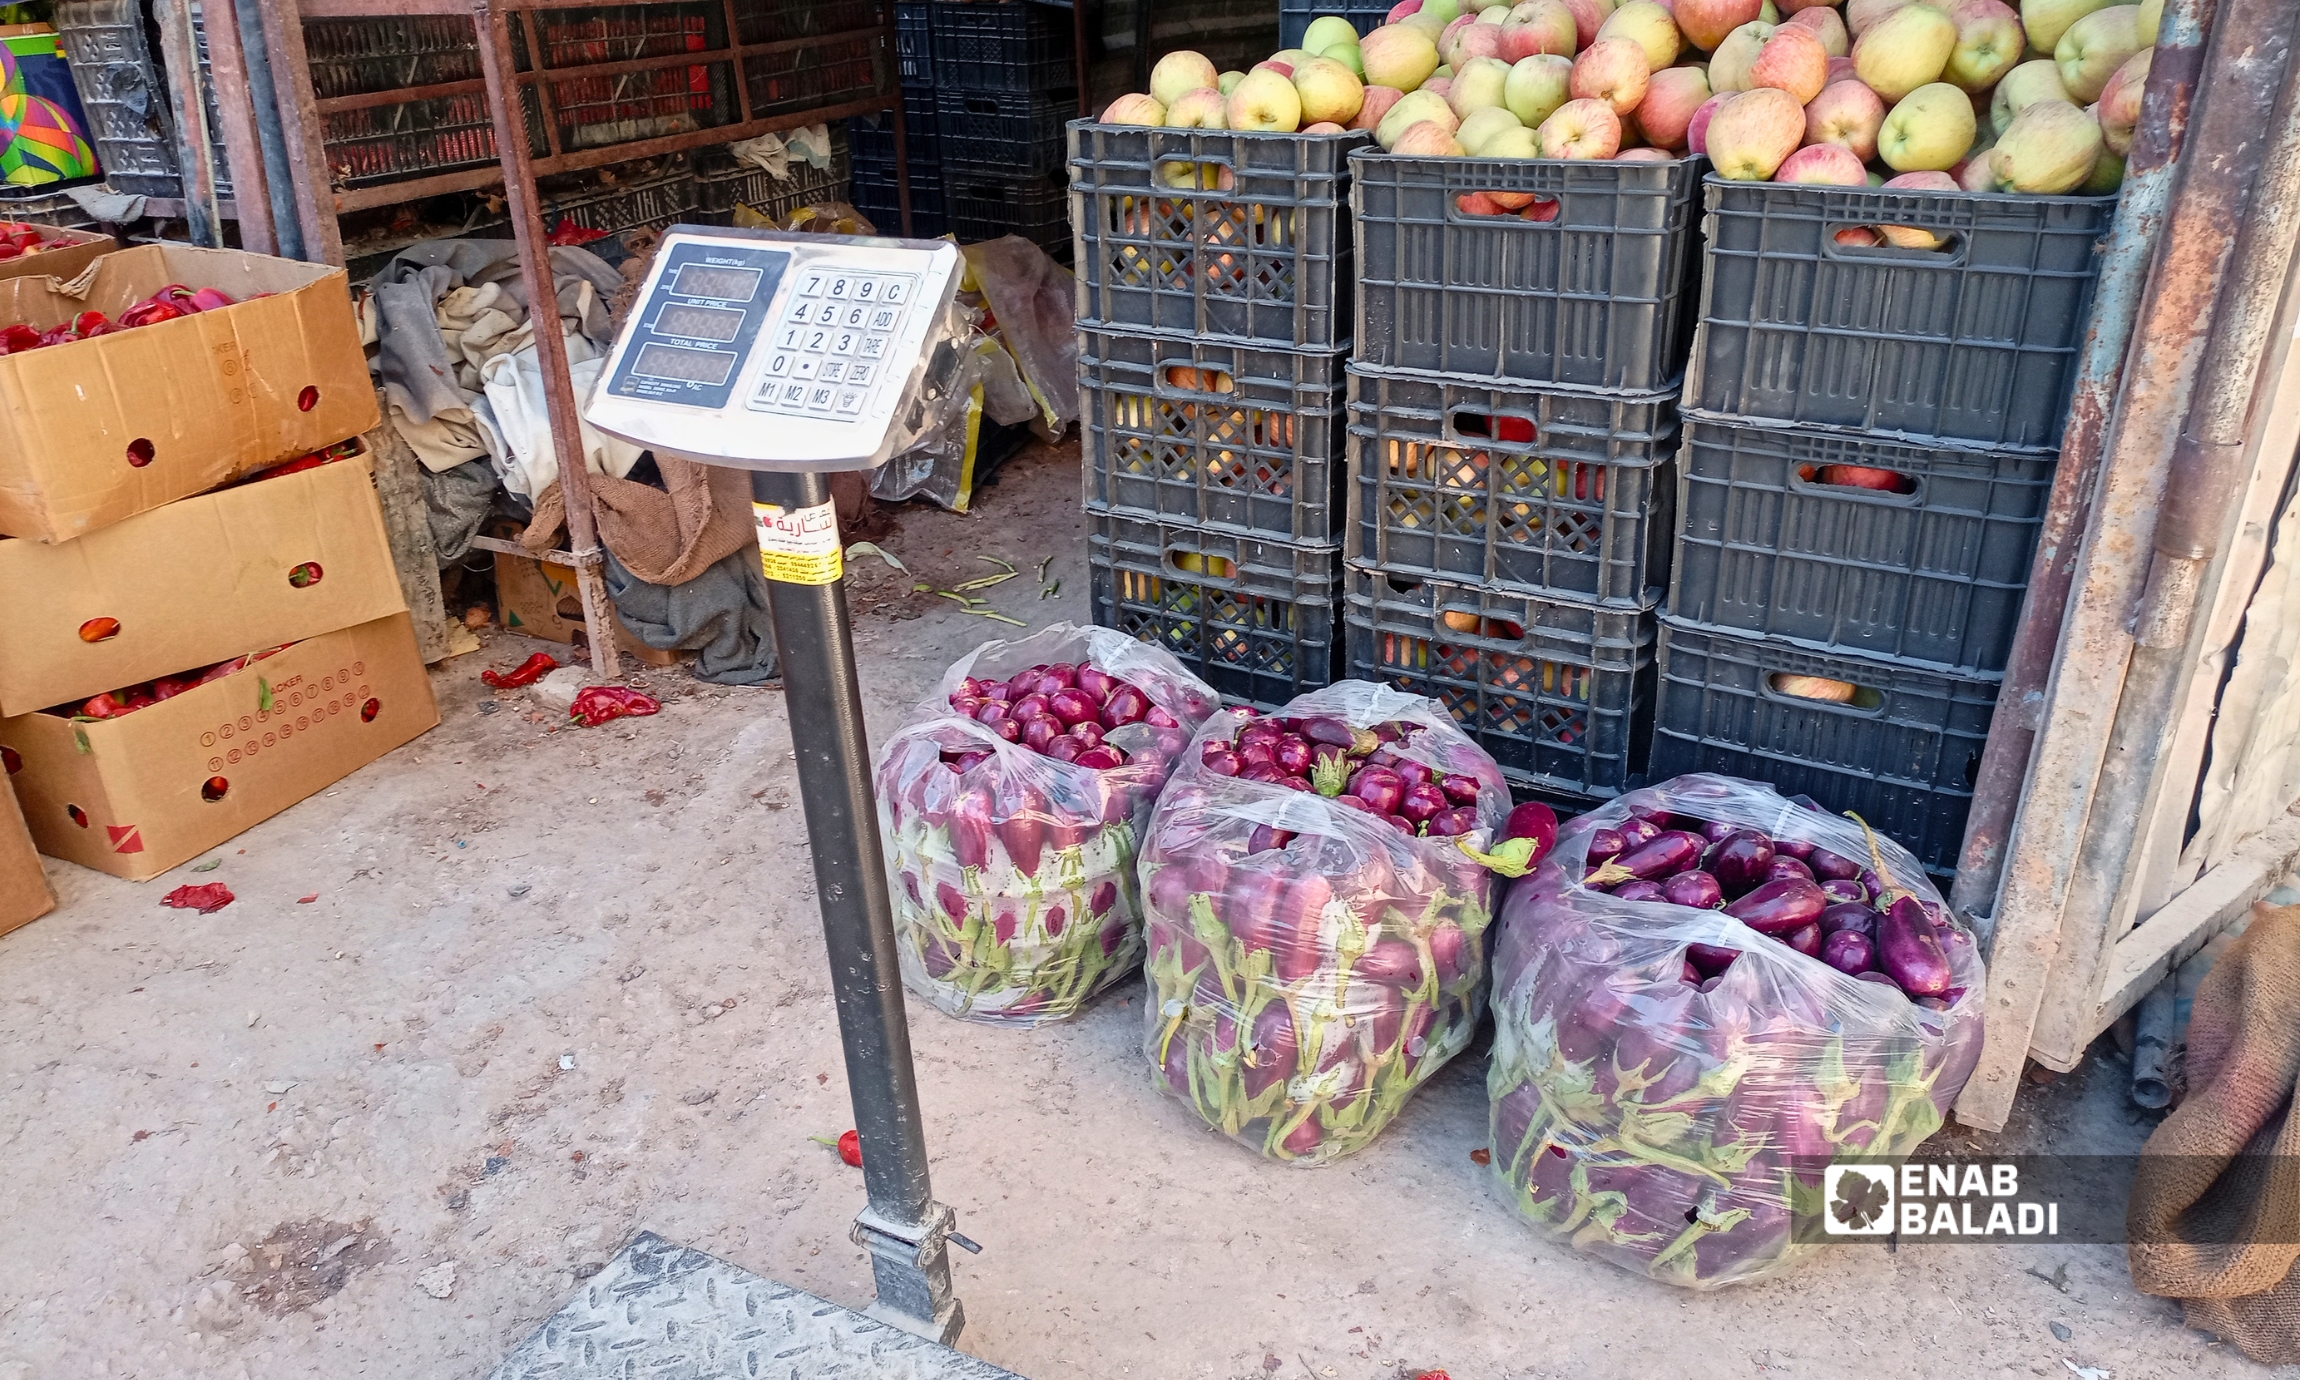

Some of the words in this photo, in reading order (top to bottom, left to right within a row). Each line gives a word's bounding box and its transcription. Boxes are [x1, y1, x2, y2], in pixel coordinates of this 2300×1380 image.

[807, 277, 820, 293] 7
[832, 279, 846, 295] 8
[860, 282, 872, 298] 9
[888, 284, 900, 299] C
[704, 300, 728, 308] PRICE
[794, 303, 808, 319] 4
[821, 306, 835, 322] 5
[849, 308, 862, 324] 6
[872, 311, 893, 327] ADD
[670, 339, 692, 347] TOTAL
[695, 342, 718, 350] PRICE
[787, 329, 795, 345] 1
[810, 332, 824, 348] 2
[838, 335, 850, 351] 3
[772, 355, 785, 372] 0
[758, 382, 775, 397] M1
[784, 385, 802, 401] M2
[811, 388, 830, 404] M3
[270, 675, 303, 694] ACKER
